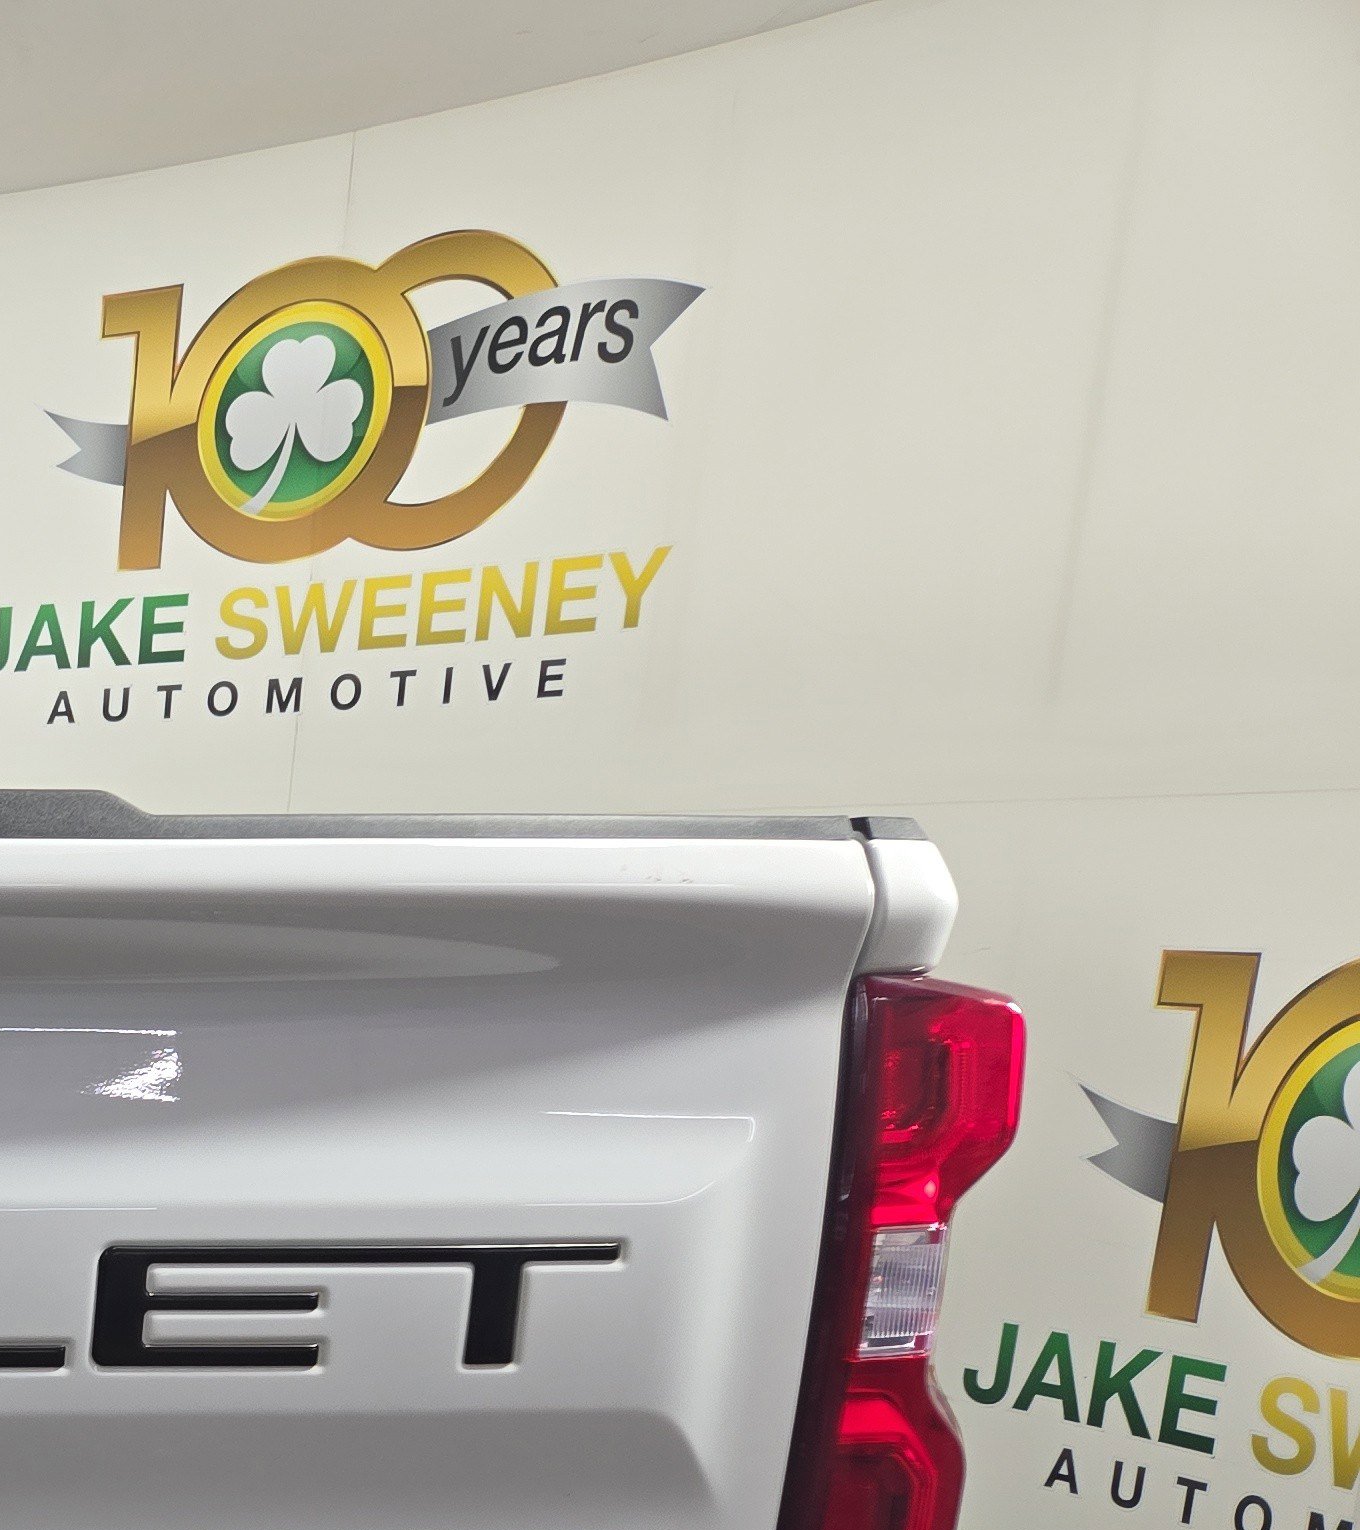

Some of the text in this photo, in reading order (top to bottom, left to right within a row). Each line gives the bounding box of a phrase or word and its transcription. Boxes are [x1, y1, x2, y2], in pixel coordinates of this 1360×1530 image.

[443, 295, 640, 406] years
[214, 545, 673, 661] SWEENEY
[46, 658, 568, 725] AUTOMOTIVE
[962, 1321, 1227, 1456] JAKE
